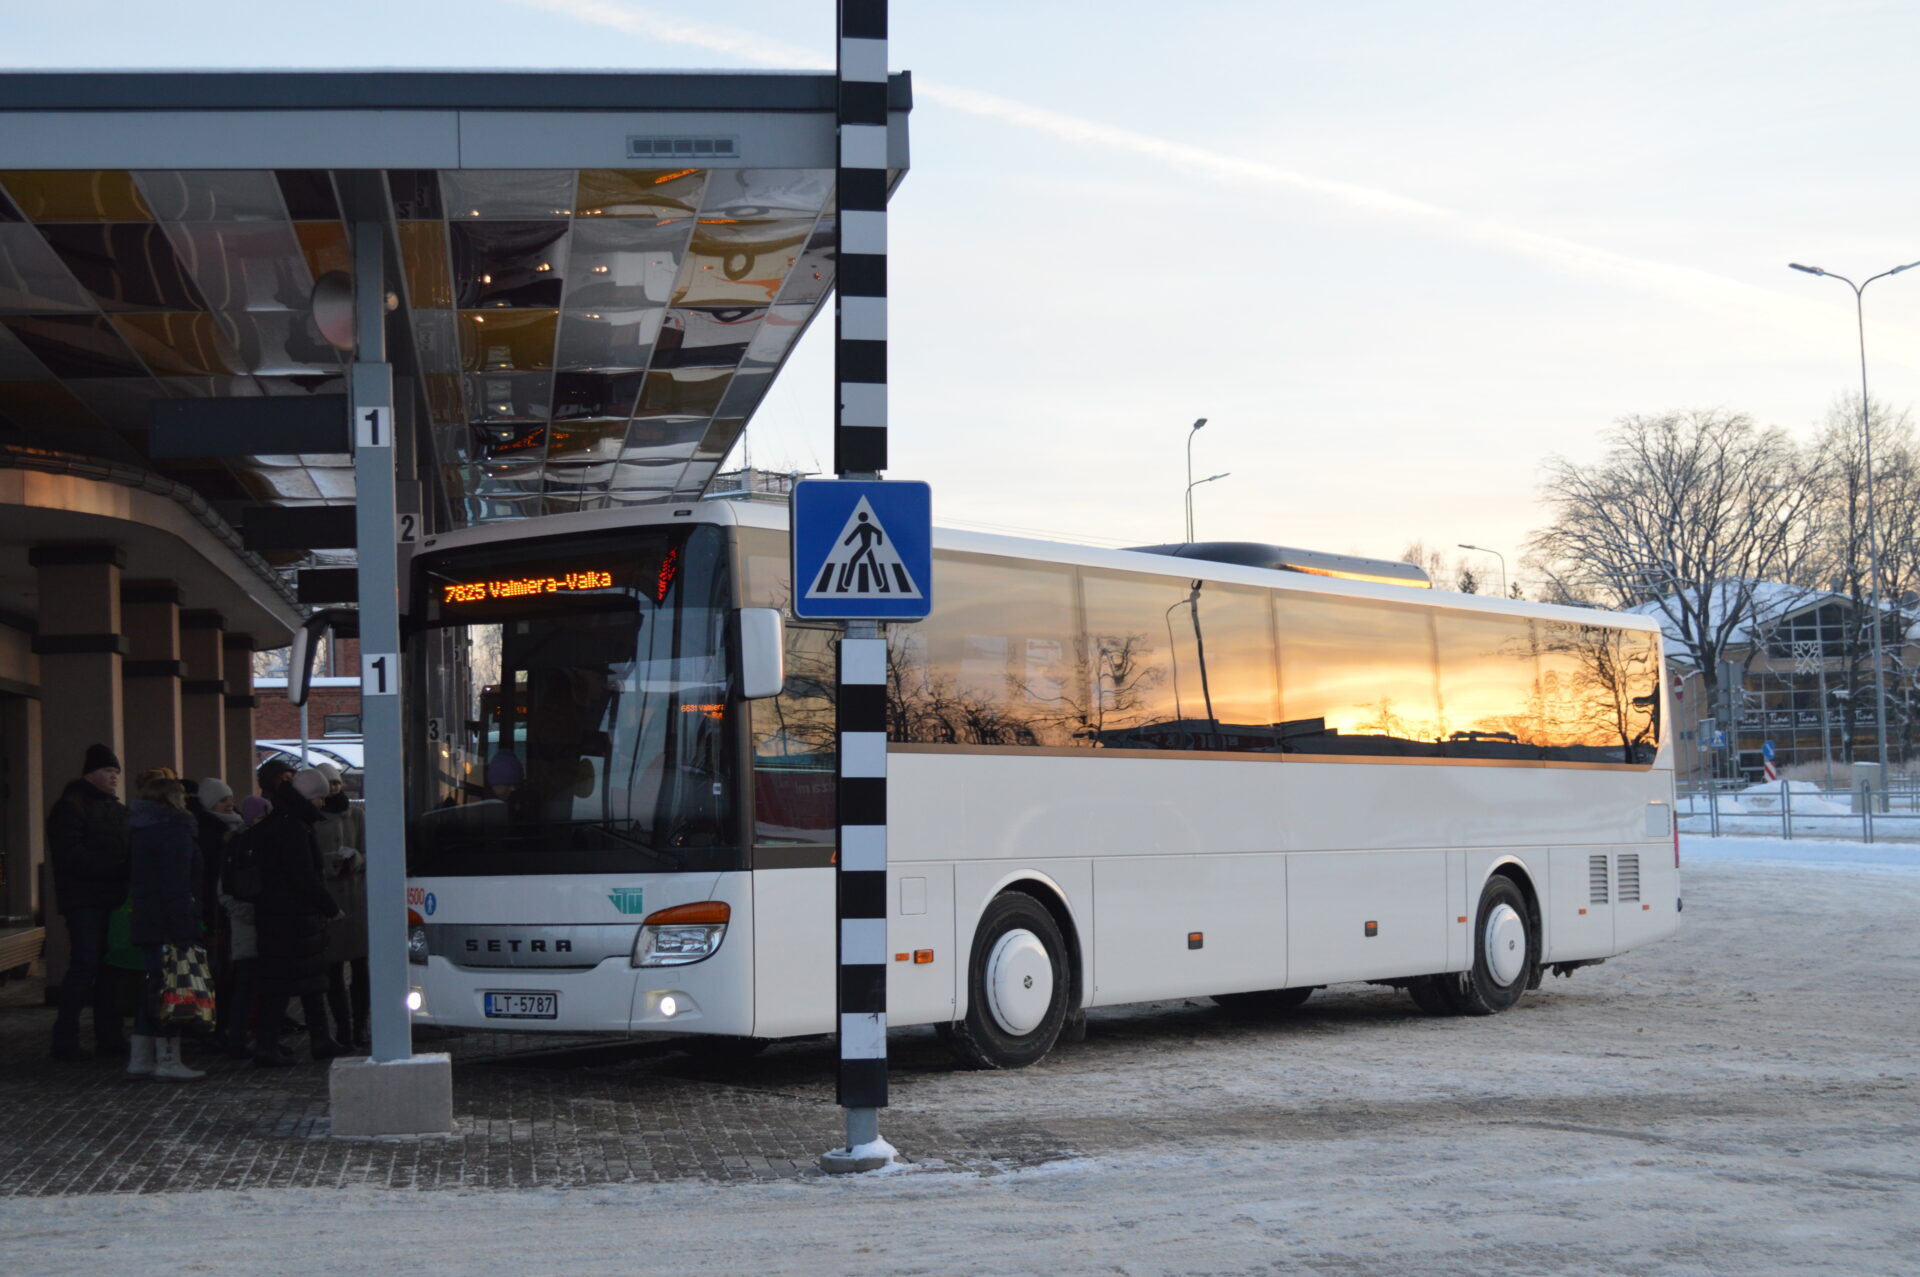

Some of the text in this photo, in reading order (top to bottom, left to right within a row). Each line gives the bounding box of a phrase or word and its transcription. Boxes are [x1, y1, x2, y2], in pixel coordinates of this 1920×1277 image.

[364, 408, 380, 445] 1
[401, 514, 416, 542] 2
[444, 570, 613, 604] 7825 Valmiera-Valka
[371, 656, 386, 694] 1
[428, 719, 439, 741] 3
[465, 938, 573, 953] SETRA
[494, 996, 553, 1014] LT-5787
